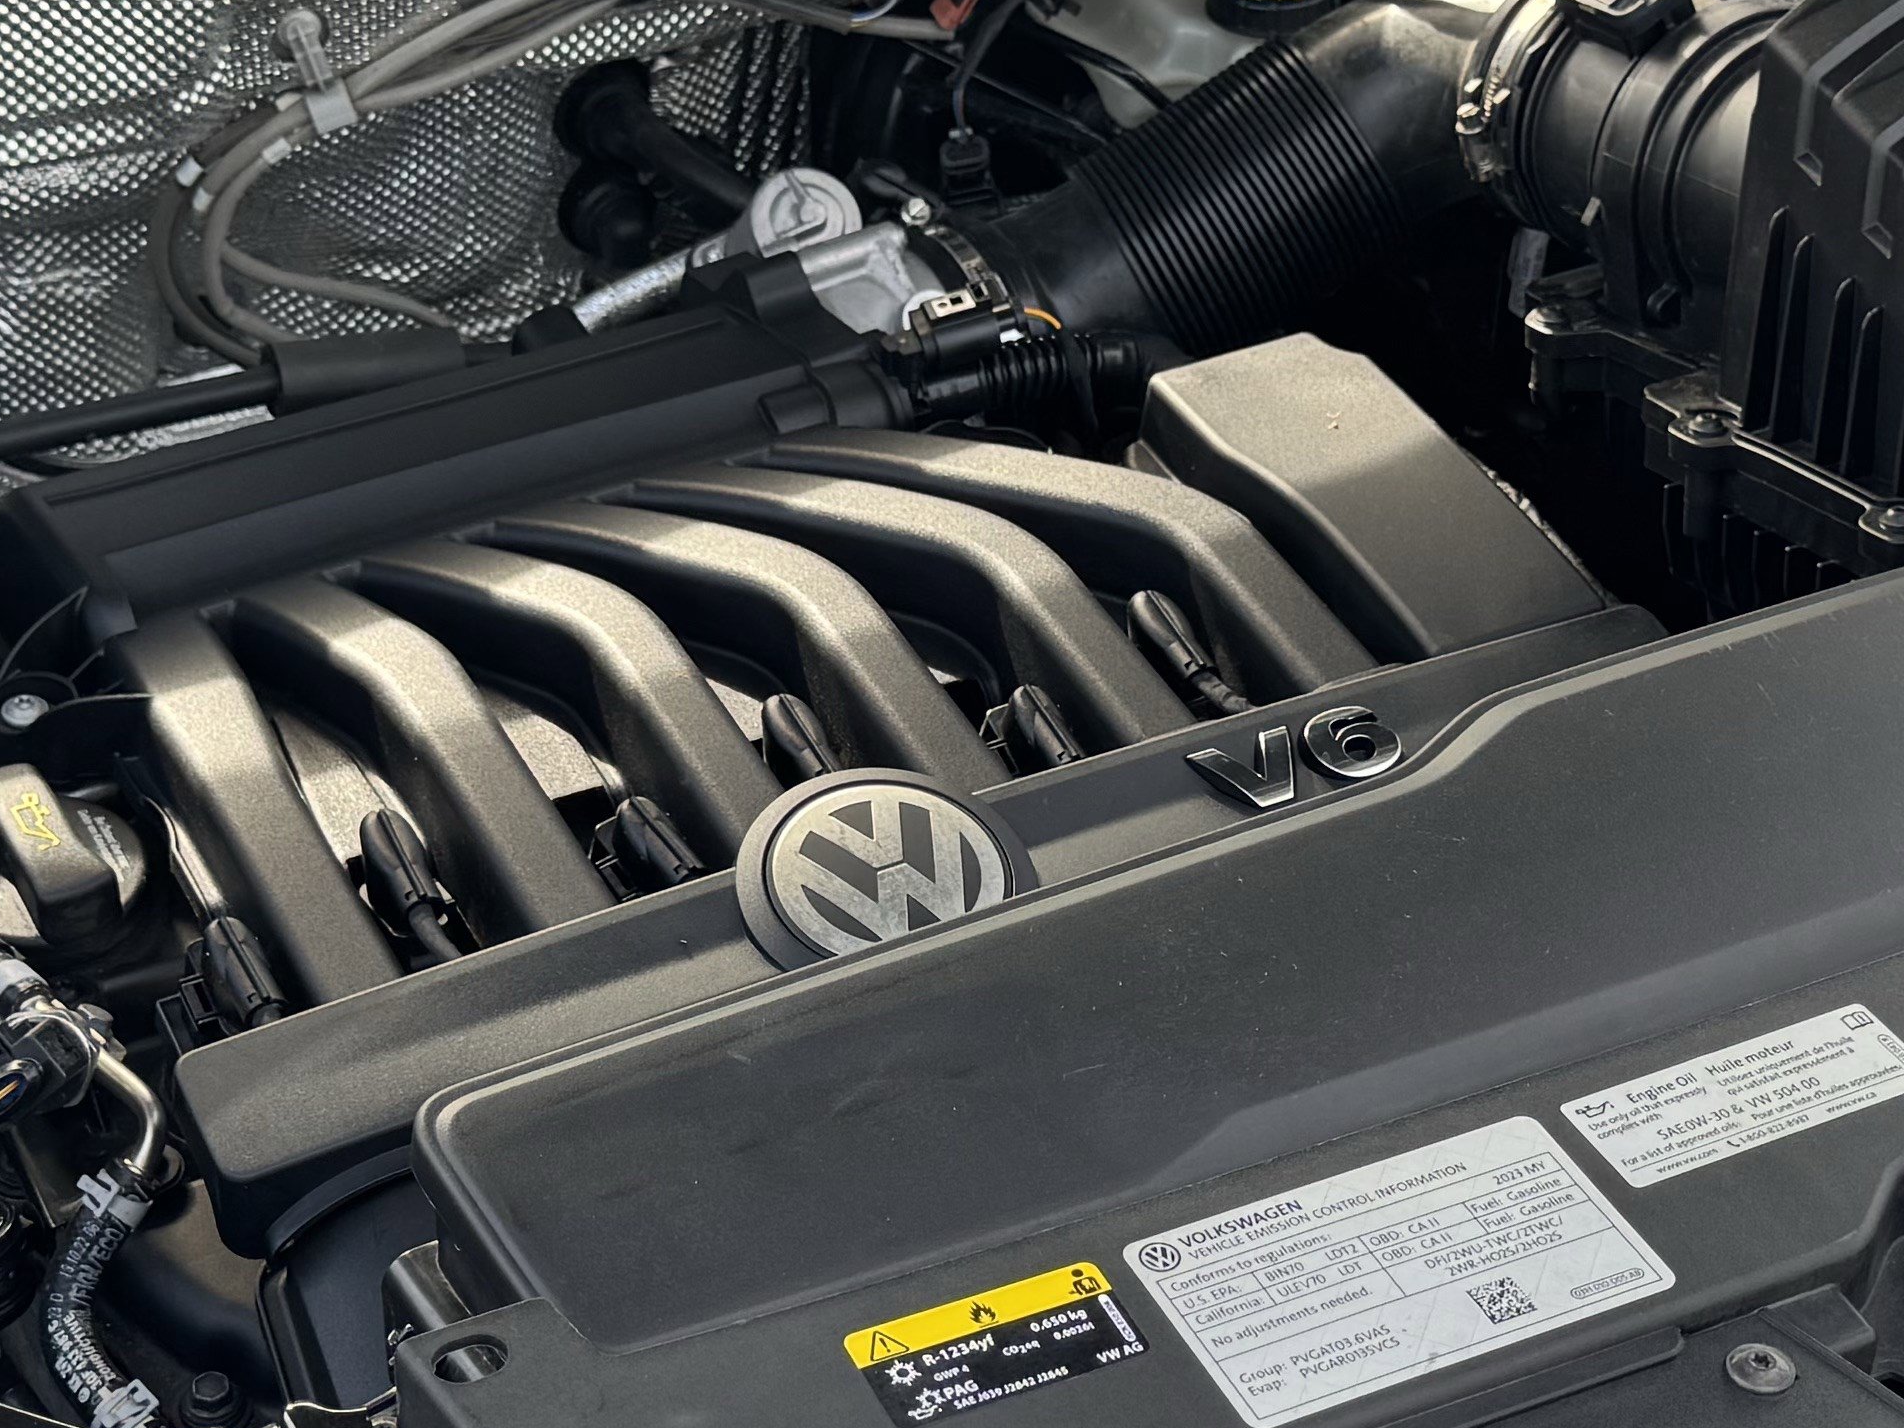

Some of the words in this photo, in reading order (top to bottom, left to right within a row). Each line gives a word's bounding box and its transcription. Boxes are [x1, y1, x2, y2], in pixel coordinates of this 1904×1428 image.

[1186, 705, 1402, 809] V6
[1704, 1058, 1744, 1076] Huile
[1743, 1040, 1794, 1063] moteur
[1753, 1049, 1812, 1074] uniquement
[1625, 1082, 1675, 1104] Engine
[1674, 1071, 1698, 1087] Oil
[1729, 1103, 1745, 1114] &
[1743, 1092, 1772, 1108] VW
[1771, 1083, 1801, 1100] 504
[1799, 1075, 1820, 1090] 00
[1587, 1120, 1608, 1131] Use
[1596, 1120, 1640, 1140] complies
[1749, 1108, 1774, 1121] Pour
[1620, 1156, 1639, 1167] For
[1675, 1126, 1721, 1148] approved
[1491, 1167, 1523, 1185] 2023
[1522, 1160, 1545, 1174] MY
[1177, 1199, 1302, 1247] VOLKSWAGEN
[1187, 1234, 1245, 1259] VEHICLE
[1245, 1212, 1311, 1241] EMISSION
[1311, 1192, 1375, 1219] CONTROL
[1374, 1161, 1467, 1198] INFORMATION
[1182, 1294, 1210, 1309] U.S.
[1209, 1284, 1242, 1300] EPA:
[1263, 1261, 1304, 1281] BIN70
[1324, 1243, 1358, 1261] LDT2
[1368, 1229, 1404, 1246] OBD:
[1407, 1221, 1429, 1234] CA
[1469, 1196, 1503, 1213] Fuel:
[1505, 1178, 1561, 1201] Gasoline
[1194, 1297, 1264, 1325] California:
[1275, 1273, 1326, 1297] ULEV70
[1336, 1260, 1362, 1276] LDT
[1380, 1245, 1416, 1261] OBD:
[1419, 1236, 1441, 1249] CA
[1482, 1211, 1515, 1228] Fuel:
[1518, 1193, 1574, 1216] Gasoline
[1170, 1265, 1236, 1292] Conforms
[1235, 1259, 1252, 1270] to
[1253, 1234, 1331, 1264] regulations:
[1210, 1334, 1233, 1348] No
[1235, 1305, 1318, 1340] adjustments
[1319, 1286, 1372, 1310] needed.
[63, 1310, 118, 1383] CONDUCTIVE
[921, 1333, 994, 1366] R-1234yf
[1029, 1313, 1067, 1332] 0.650
[1065, 1306, 1090, 1324] kg
[1095, 1347, 1121, 1363] VW
[1122, 1340, 1144, 1356] AG
[932, 1366, 960, 1381] GWP
[942, 1379, 979, 1399] PAG
[1238, 1362, 1287, 1383] Group:
[1246, 1378, 1287, 1396] Evap:
[952, 1394, 977, 1409] SAE
